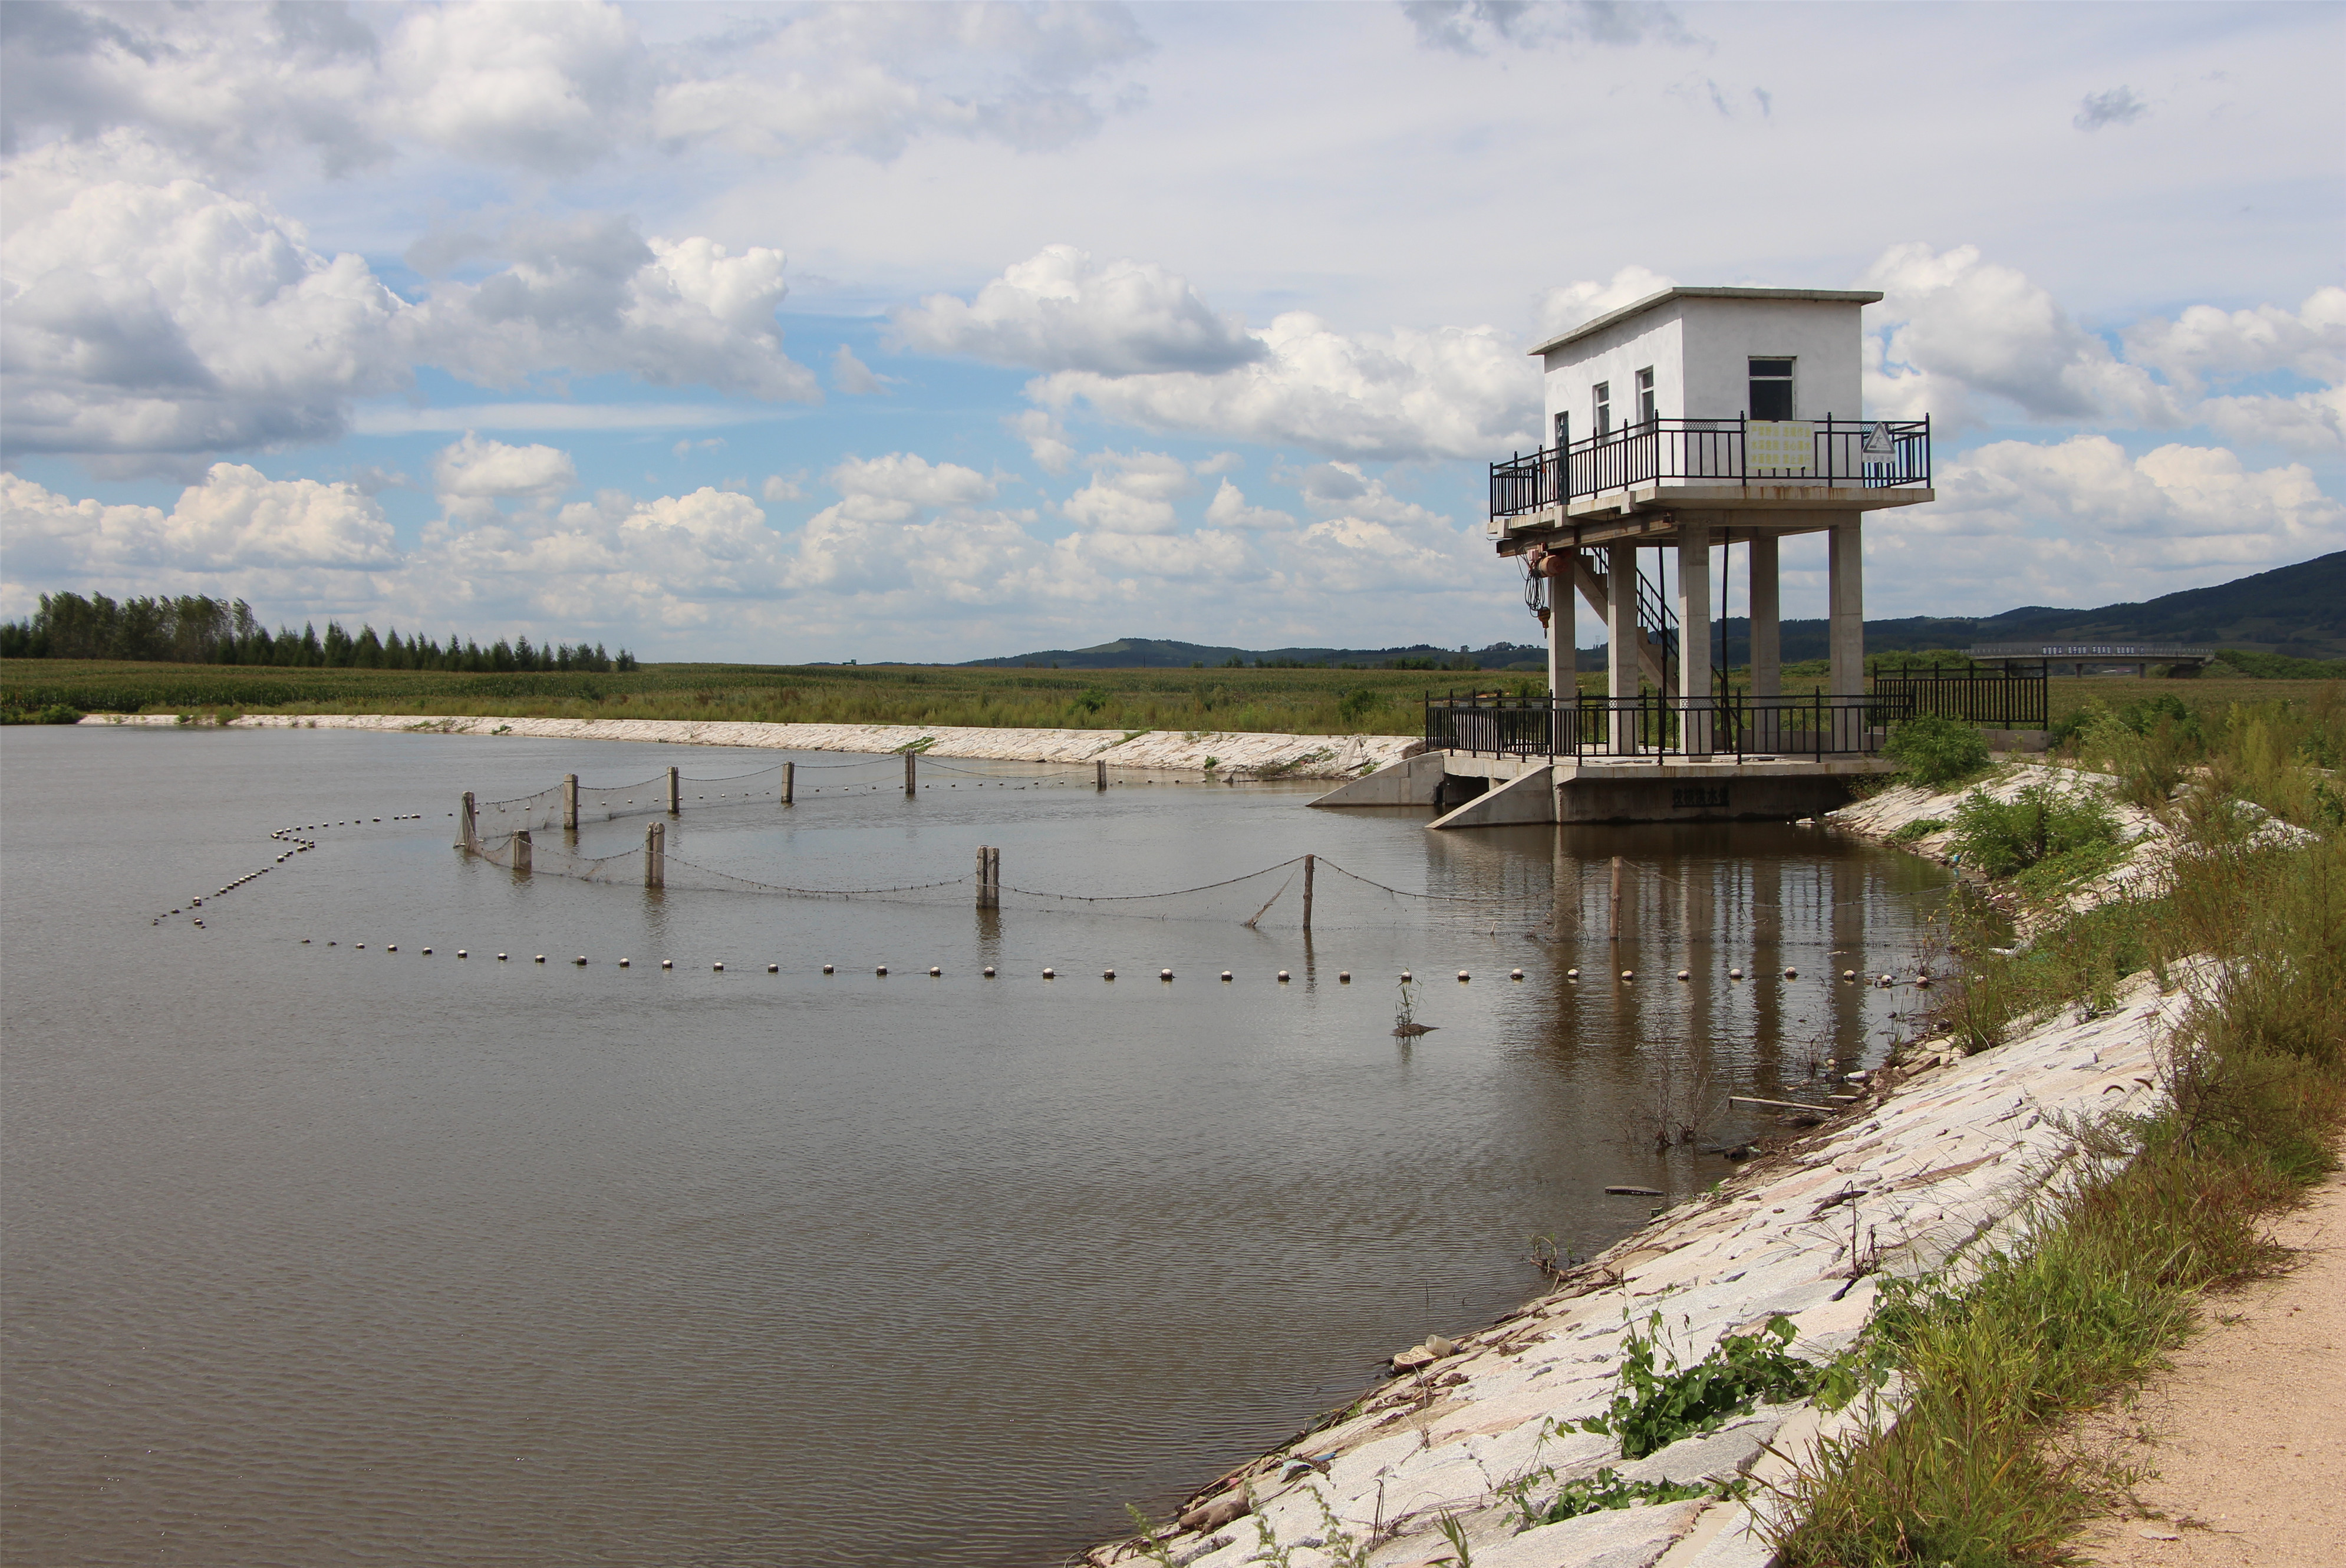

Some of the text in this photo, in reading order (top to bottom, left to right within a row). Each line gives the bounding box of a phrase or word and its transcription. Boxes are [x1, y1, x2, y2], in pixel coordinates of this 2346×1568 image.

[1782, 426, 1811, 437] 违规作业
[1751, 439, 1811, 451] 水深危险 当心落水
[1751, 453, 1811, 465] 冰面危险 禁止通行
